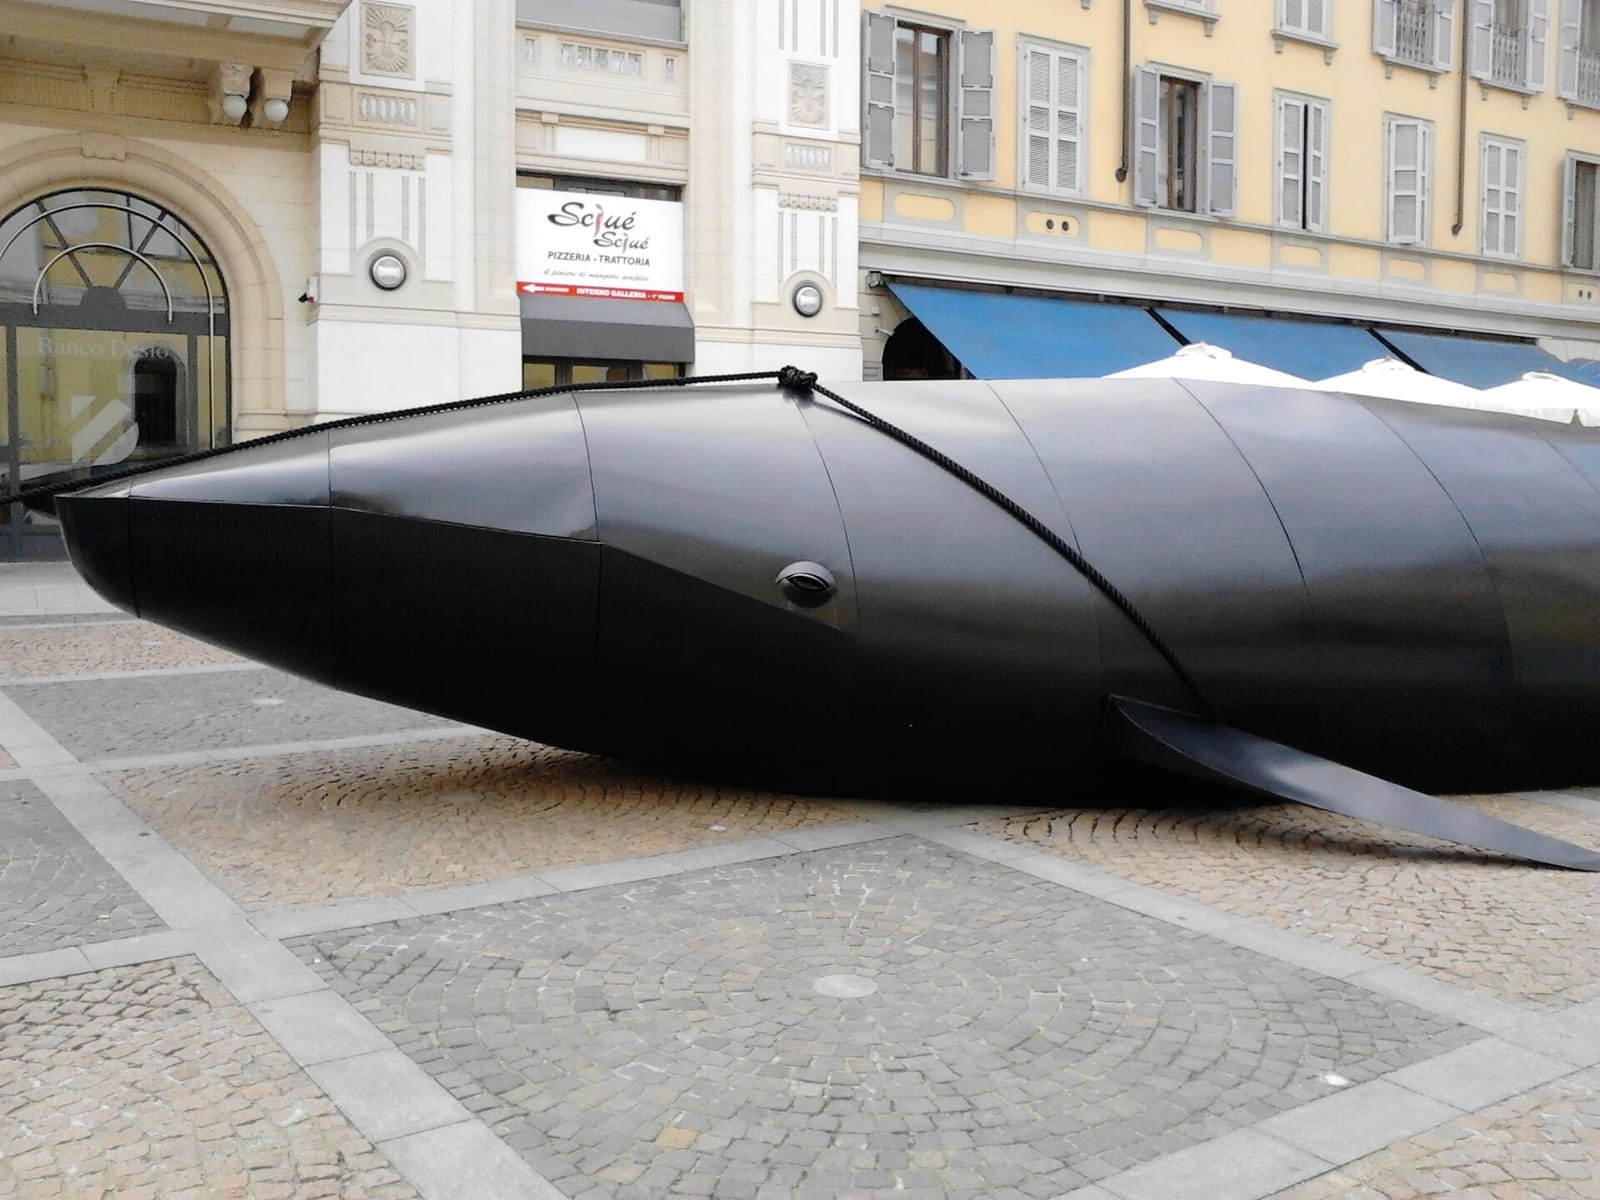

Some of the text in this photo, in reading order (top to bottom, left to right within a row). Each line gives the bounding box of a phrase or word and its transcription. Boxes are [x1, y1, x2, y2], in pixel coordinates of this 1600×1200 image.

[547, 251, 591, 262] PIZZERIA
[598, 254, 650, 266] TRATTORIA
[610, 290, 647, 299] GALLERIA
[38, 336, 169, 360] Banco Desio
